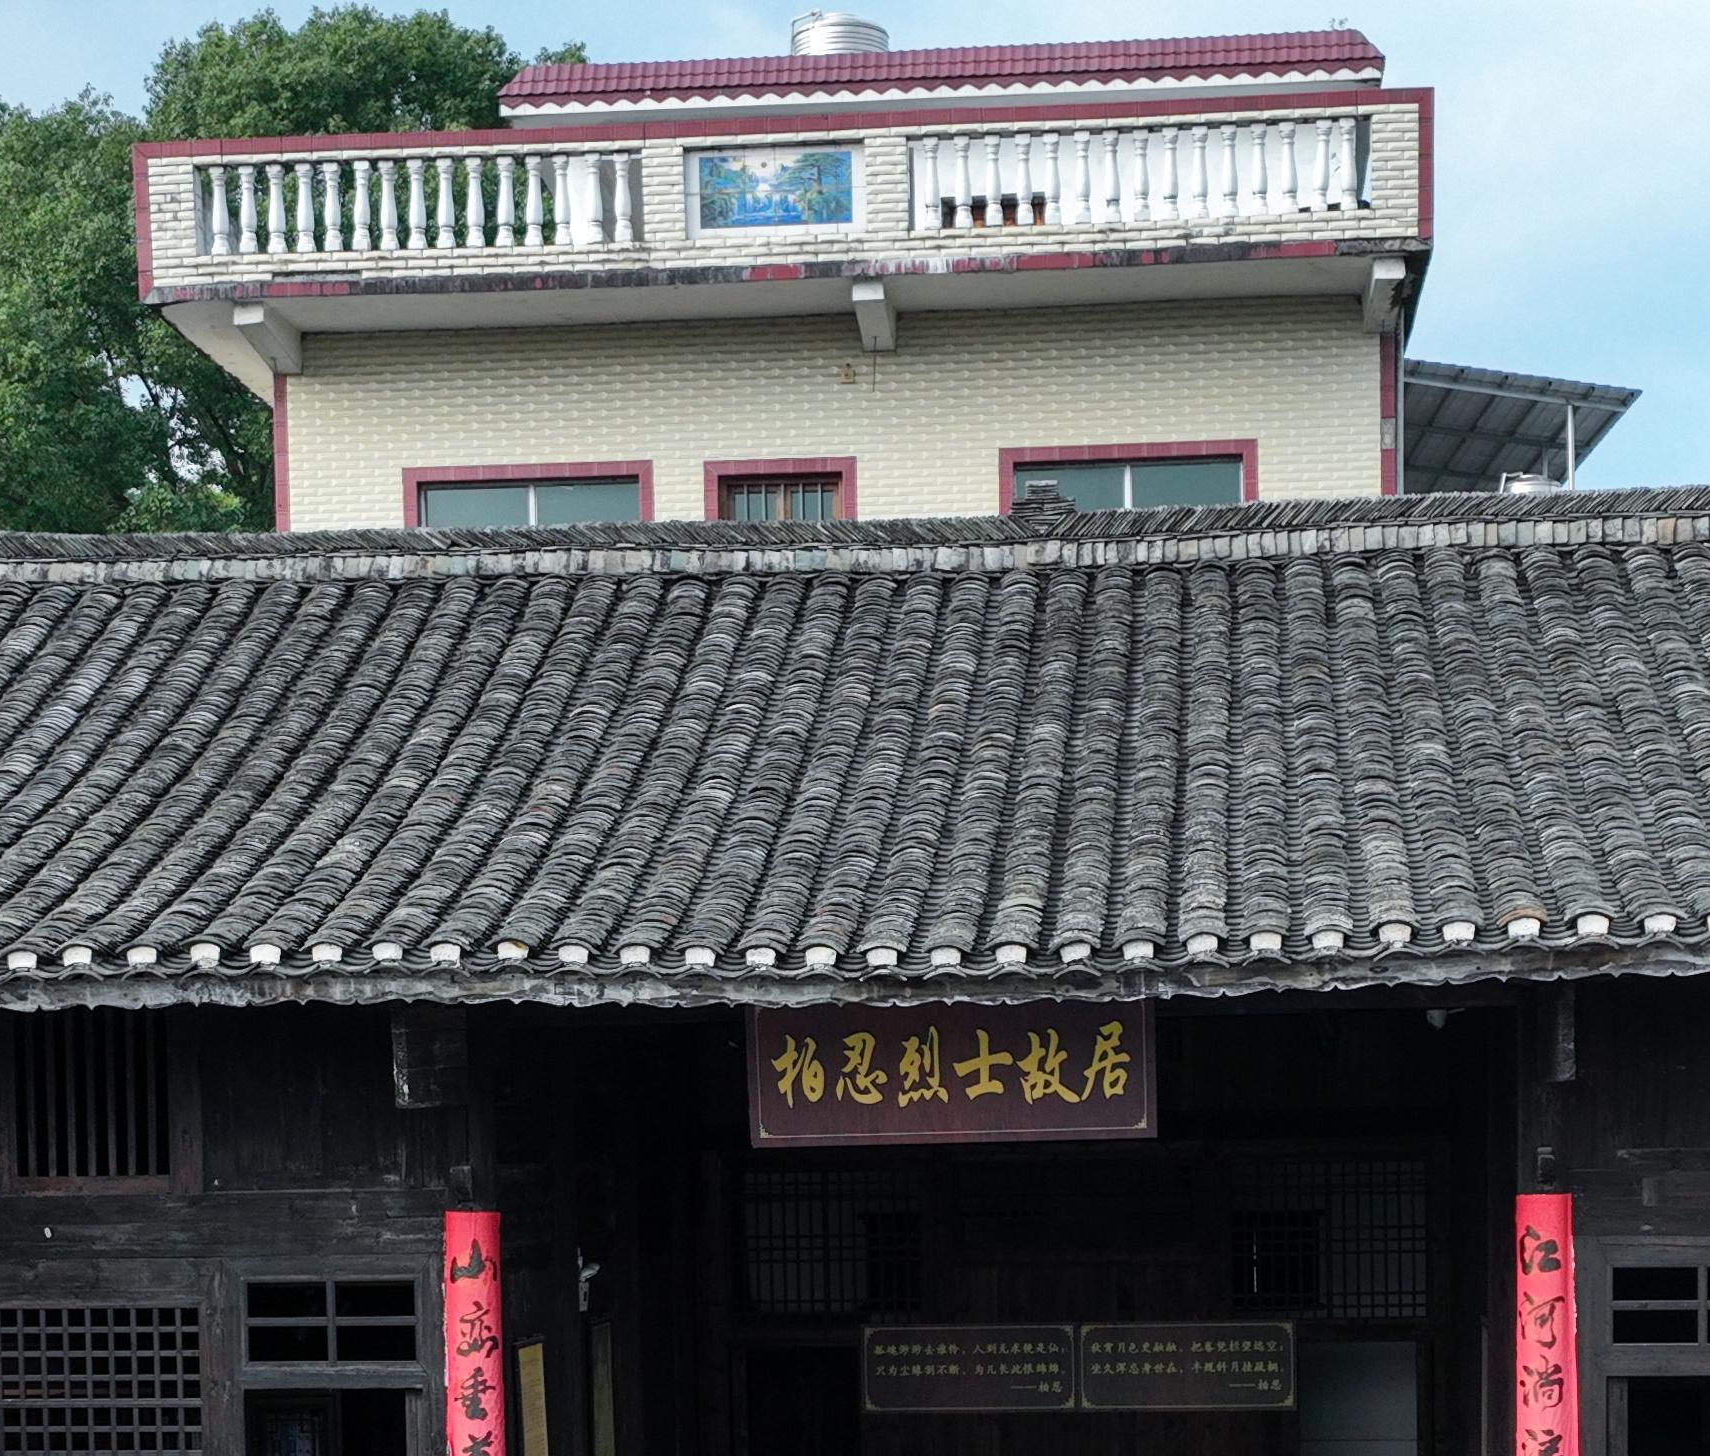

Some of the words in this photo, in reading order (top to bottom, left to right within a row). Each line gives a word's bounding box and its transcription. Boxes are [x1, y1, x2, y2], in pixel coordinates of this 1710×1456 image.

[770, 1019, 1132, 1109] 柏忍烈士故居
